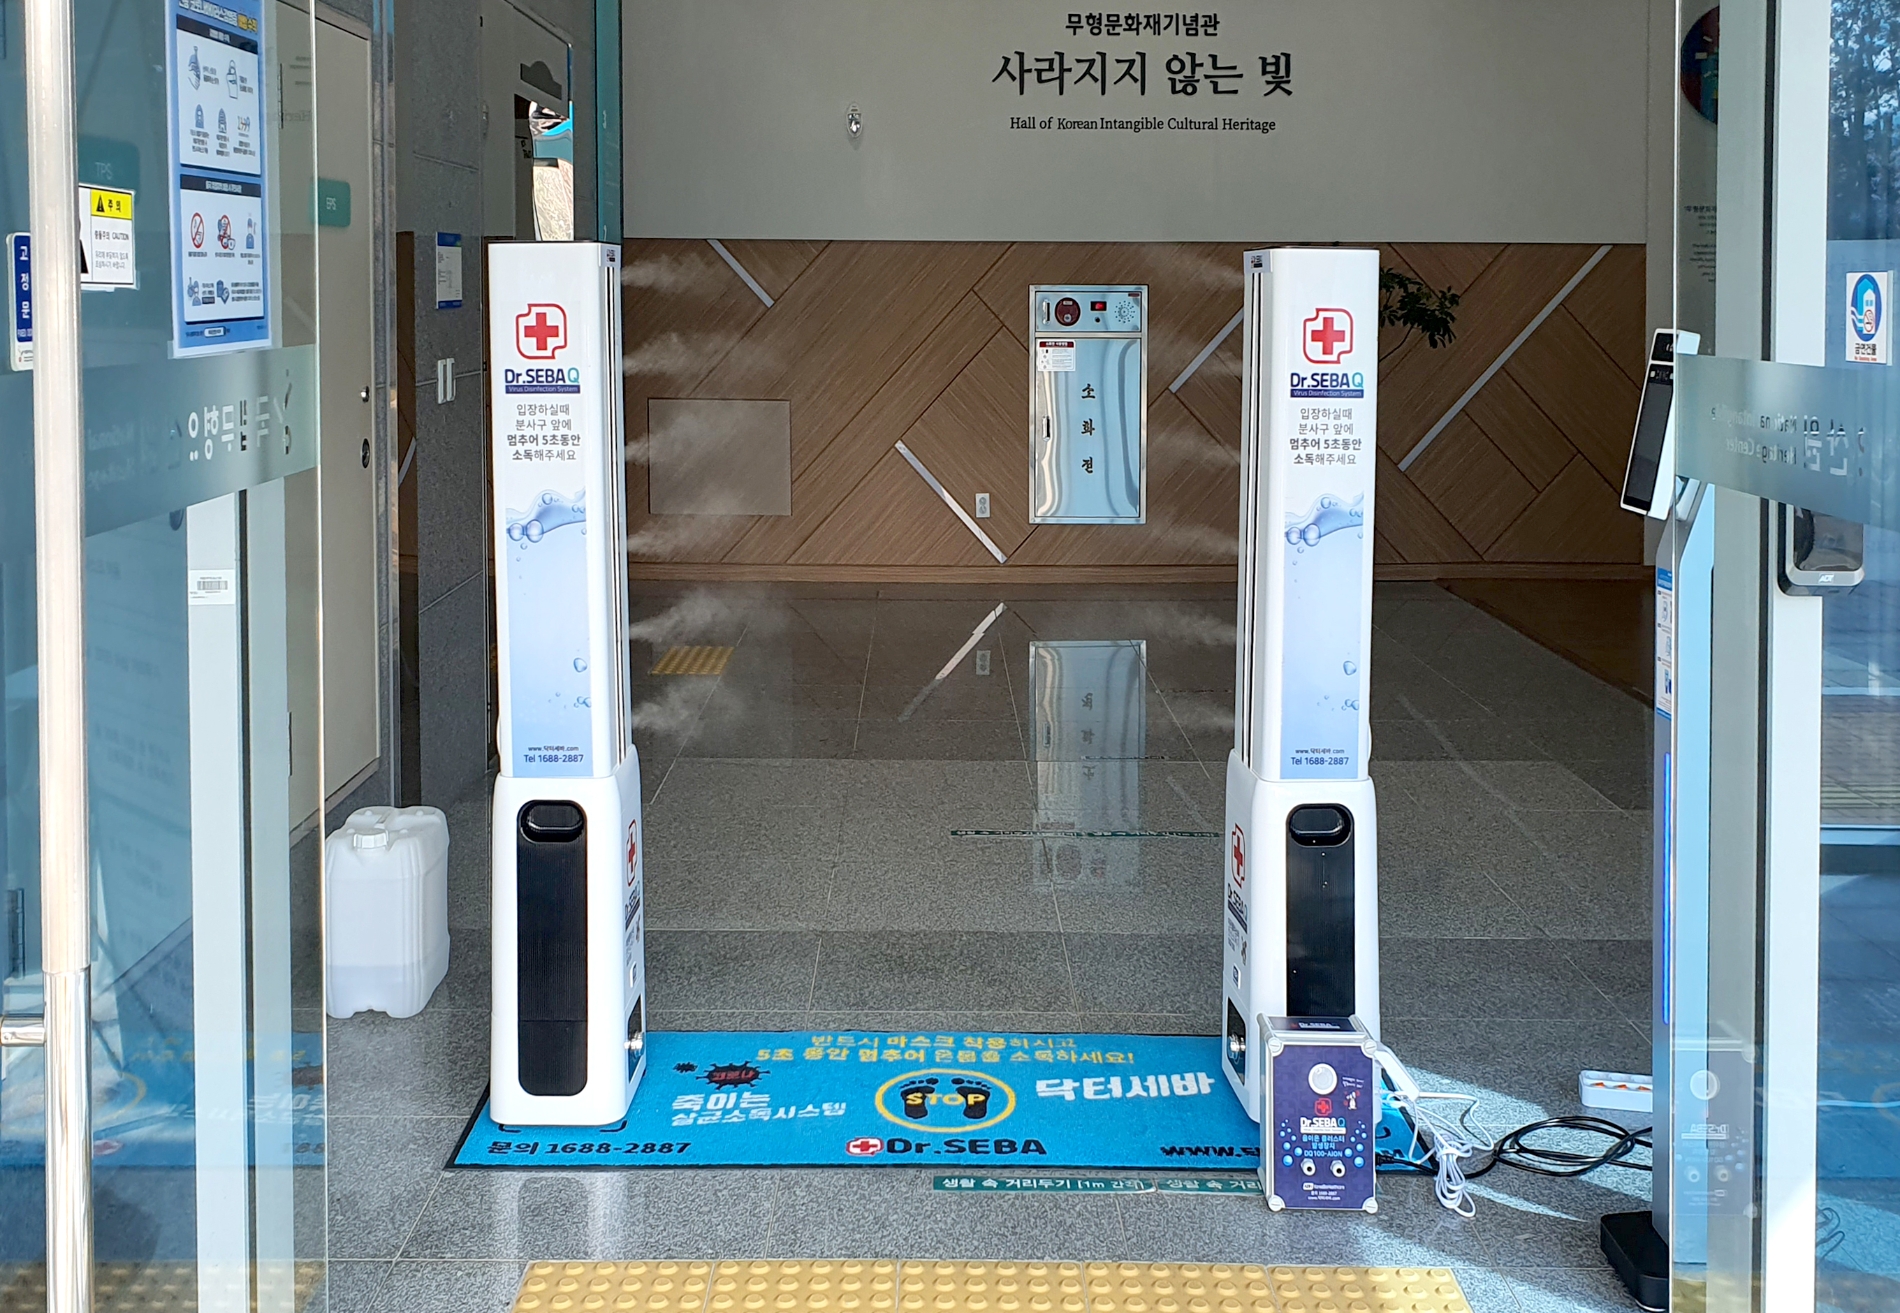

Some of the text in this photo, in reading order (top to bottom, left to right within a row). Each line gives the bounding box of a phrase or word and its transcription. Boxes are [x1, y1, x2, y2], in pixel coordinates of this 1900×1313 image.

[1065, 12, 1220, 36] 무형문화재기념관
[991, 50, 1293, 97] 사라지지 않는 빛
[1010, 116, 1276, 133] Hall of Korean Intangible Cultural Heritage
[95, 162, 112, 180] TPS
[108, 198, 122, 213] 주의
[326, 196, 337, 210] EPS
[557, 386, 578, 394] System
[516, 403, 570, 416] 입장하실때
[1300, 408, 1353, 420] 입장하실때
[515, 419, 572, 431] 분사구 앞에
[1298, 423, 1354, 435] 분사구 앞에
[507, 434, 581, 446] 멈추어 5초동안
[1289, 438, 1362, 450] 멈추어 5초동안
[512, 449, 577, 461] 소독해주세요
[1293, 453, 1357, 466] 소독해주세요
[523, 754, 584, 763] Tel 1688-2887
[1290, 757, 1350, 765] Tel 1688-2887
[812, 1034, 1077, 1049] 반드시 마스크 착용하시고
[756, 1048, 795, 1062] 5초
[803, 1047, 849, 1061] 동안
[858, 1048, 926, 1063] 멈추어
[1009, 1050, 1135, 1064] 소독하세요!
[1035, 1072, 1215, 1101] 닥터세바
[671, 1091, 771, 1111] 죽이는
[906, 1092, 986, 1106] STOP
[487, 1141, 692, 1156] 문의 1688-2887
[886, 1137, 1048, 1155] Dr.SEBA
[942, 1177, 976, 1189] 생활
[982, 1177, 999, 1189] 속
[1005, 1178, 1071, 1189] 거리두기
